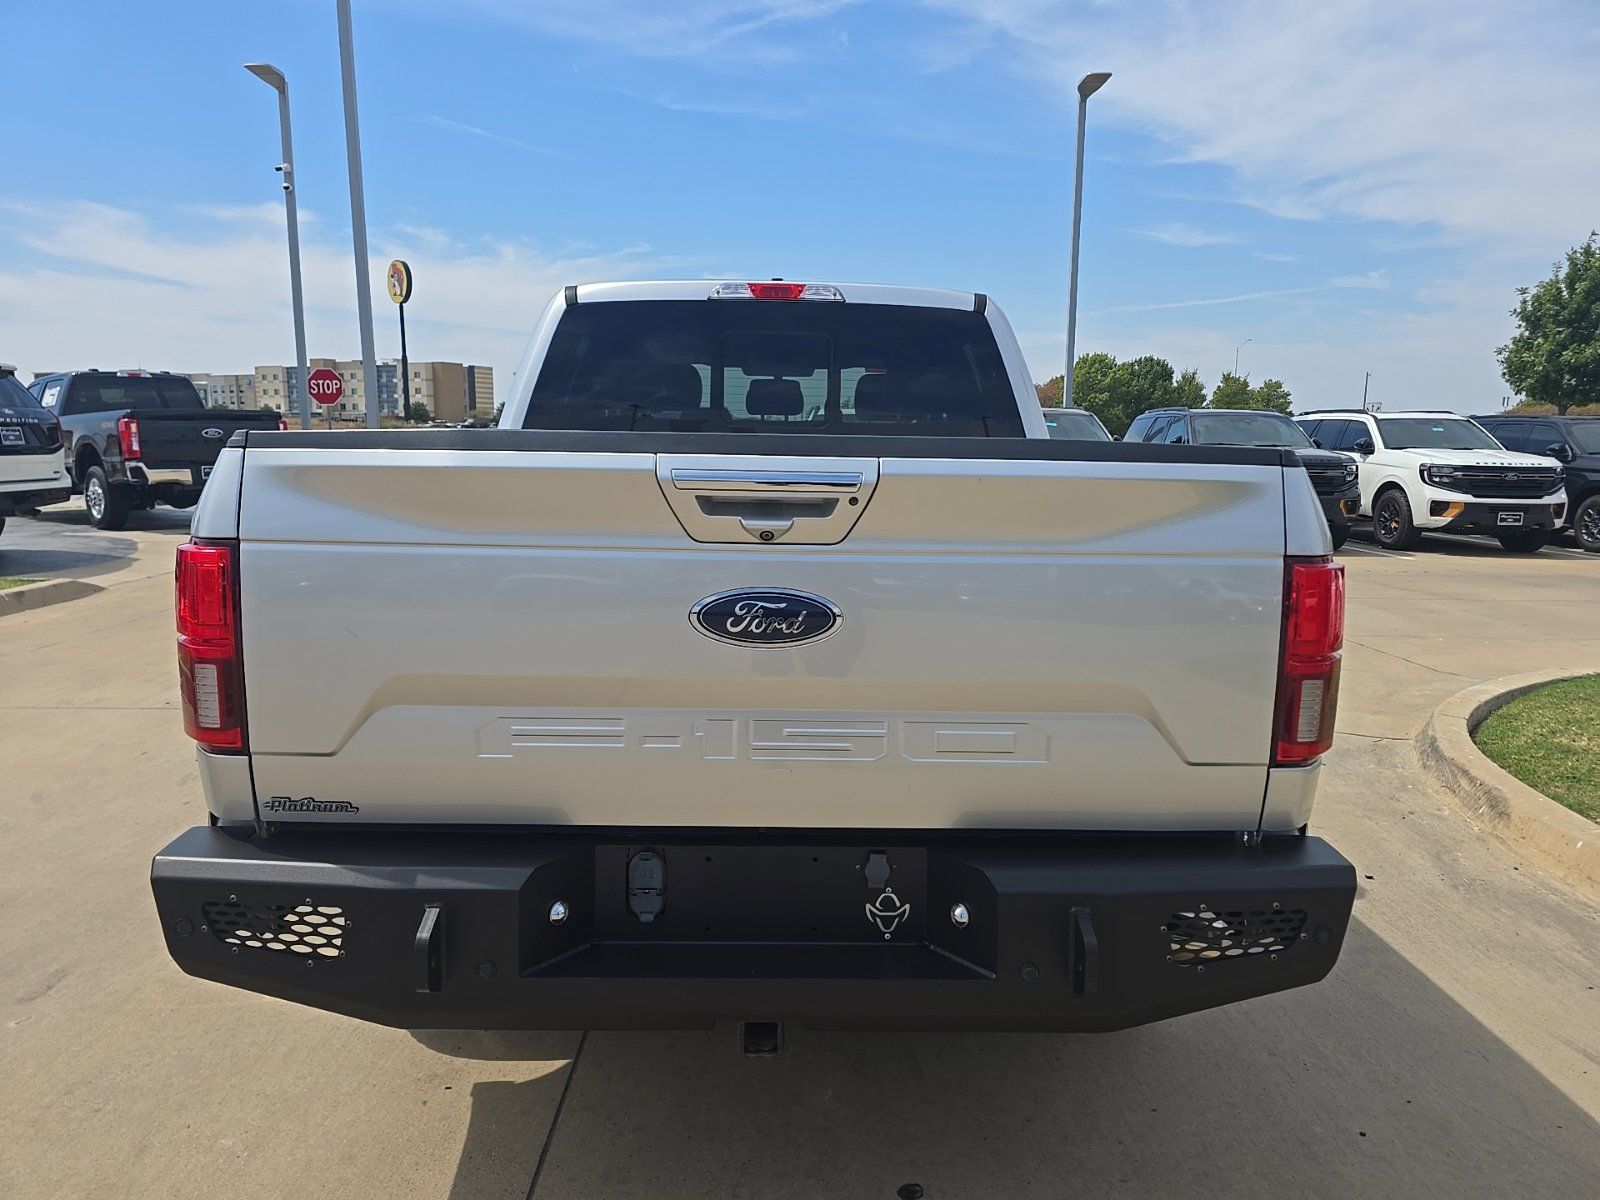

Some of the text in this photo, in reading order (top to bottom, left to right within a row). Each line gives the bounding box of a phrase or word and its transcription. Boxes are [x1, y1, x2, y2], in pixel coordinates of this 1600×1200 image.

[310, 380, 341, 394] STOP
[726, 600, 808, 634] Ford
[477, 716, 1051, 763] F-150
[263, 797, 359, 814] Platinum
